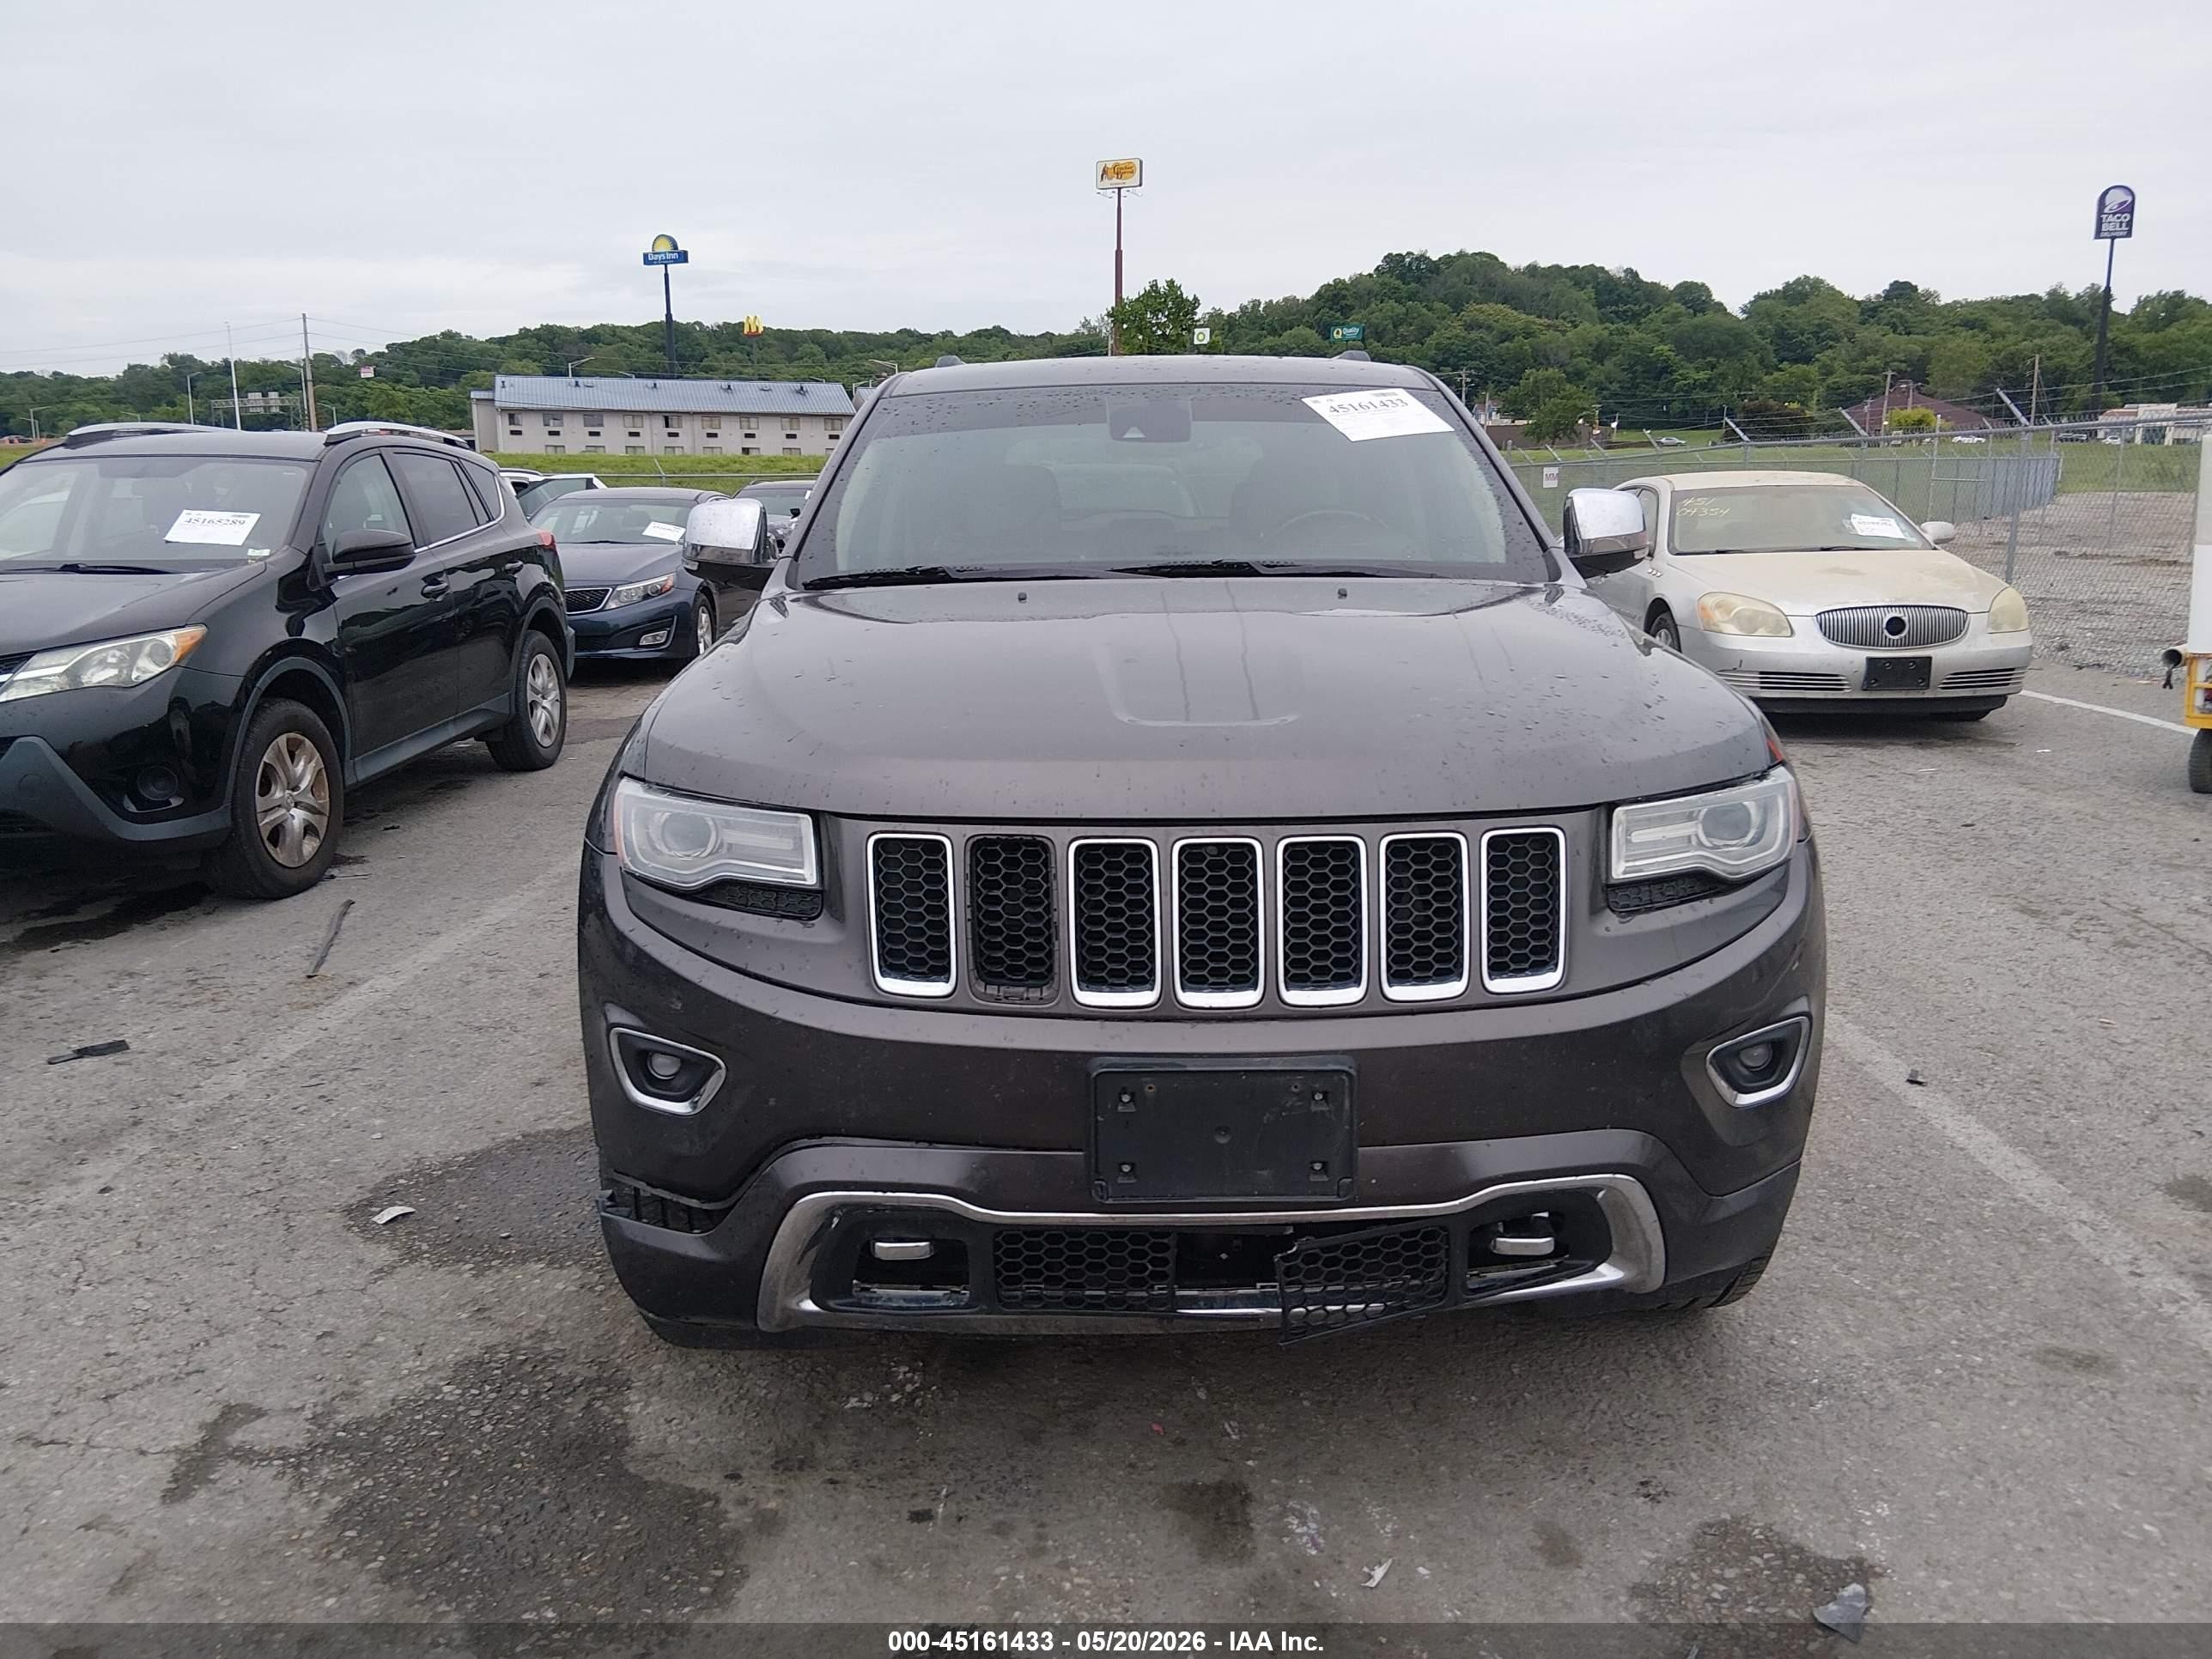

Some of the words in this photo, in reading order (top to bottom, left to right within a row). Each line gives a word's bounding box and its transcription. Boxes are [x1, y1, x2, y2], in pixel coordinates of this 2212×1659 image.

[2100, 213, 2130, 222] TACO
[2101, 222, 2130, 231] BELL
[1328, 398, 1409, 413] 45161433
[1682, 496, 1714, 507] 451
